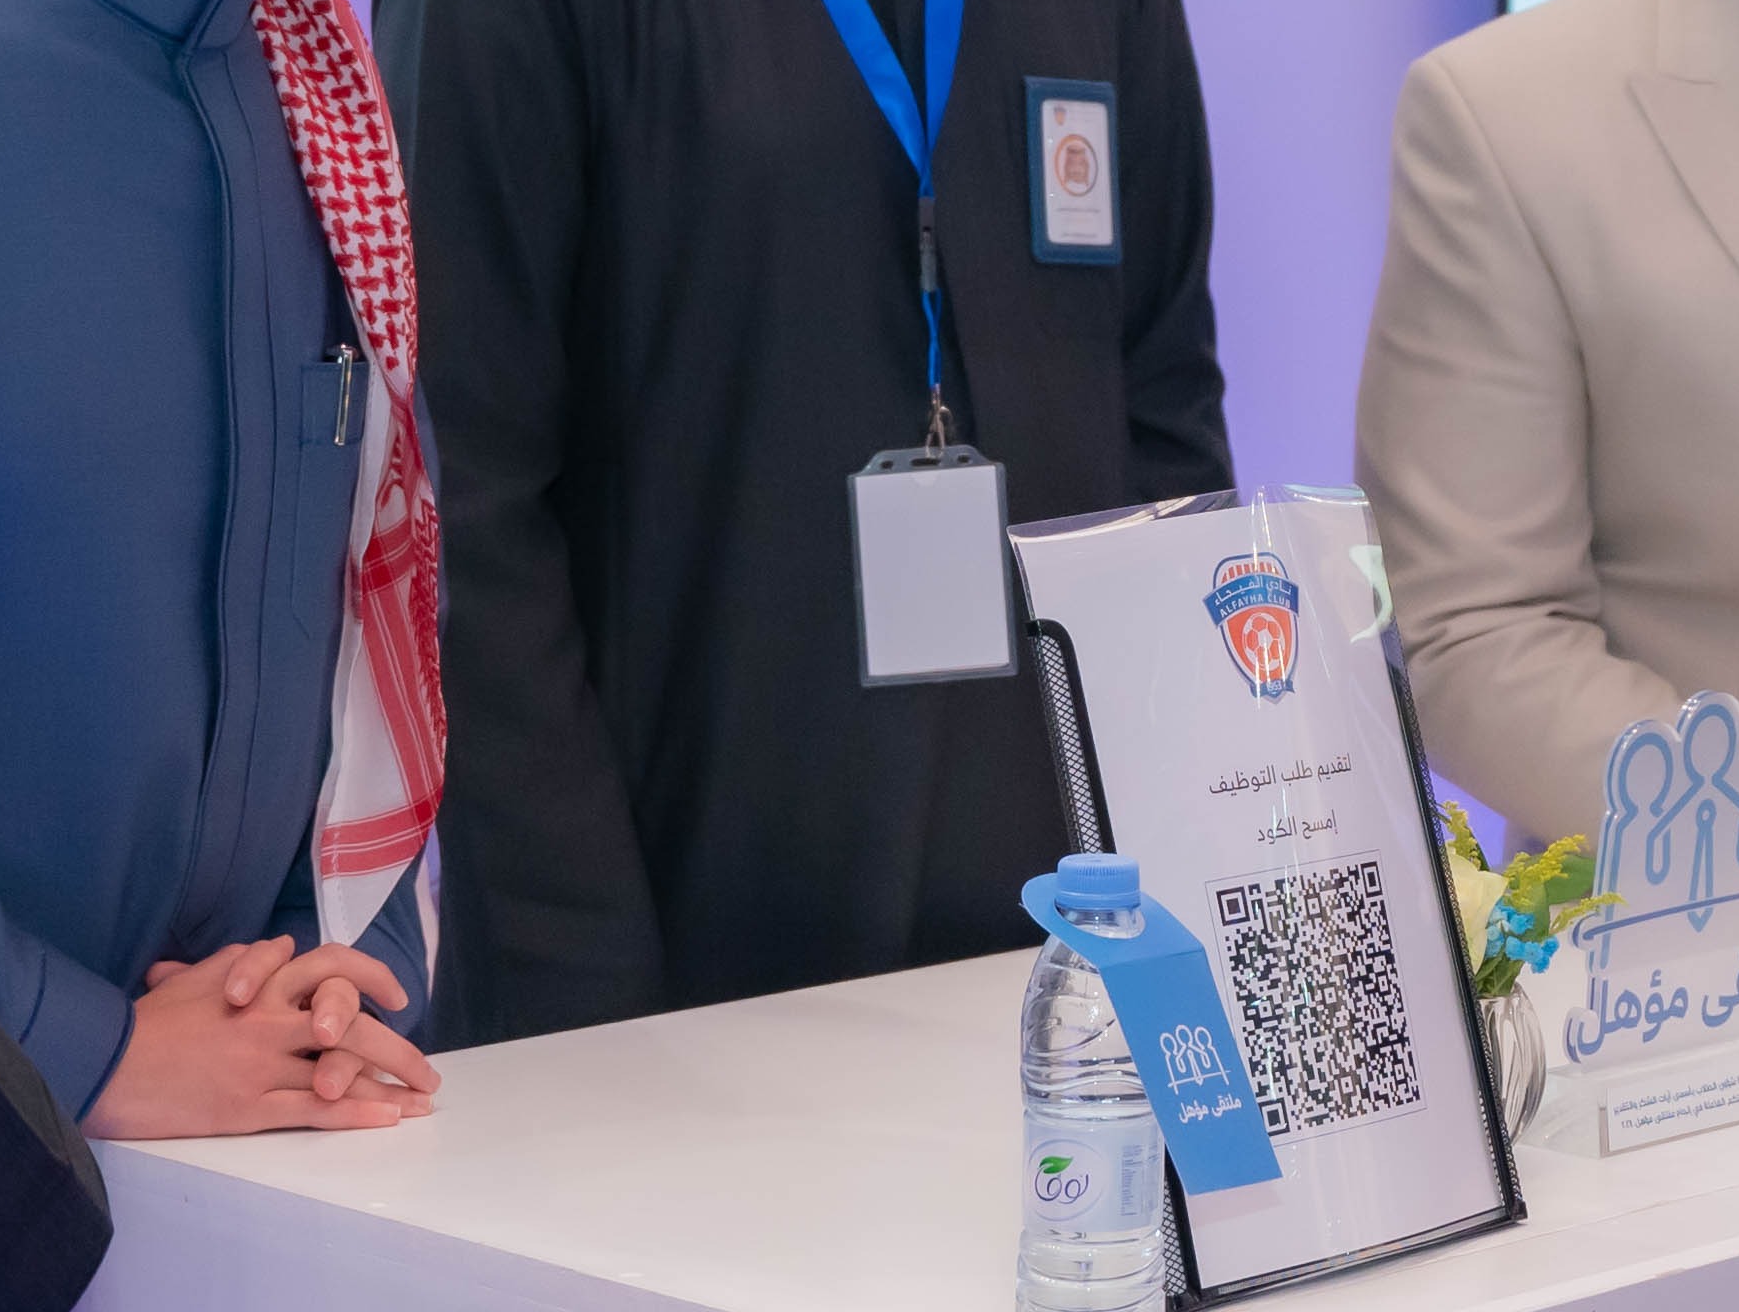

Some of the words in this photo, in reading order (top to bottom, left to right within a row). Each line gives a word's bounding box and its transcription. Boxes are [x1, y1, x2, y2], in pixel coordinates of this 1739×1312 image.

[1219, 593, 1264, 619] ALFAYHA
[1267, 592, 1292, 610] CLUB
[1209, 764, 1277, 796] التوظيف
[1281, 759, 1313, 787] طلب
[1317, 752, 1353, 783] لتقديم
[1257, 815, 1298, 845] الكود
[1301, 809, 1339, 840] إمسح
[1577, 969, 1689, 1057] مؤهل
[1179, 1101, 1210, 1124] مؤهل
[1211, 1094, 1243, 1118] ملتقى
